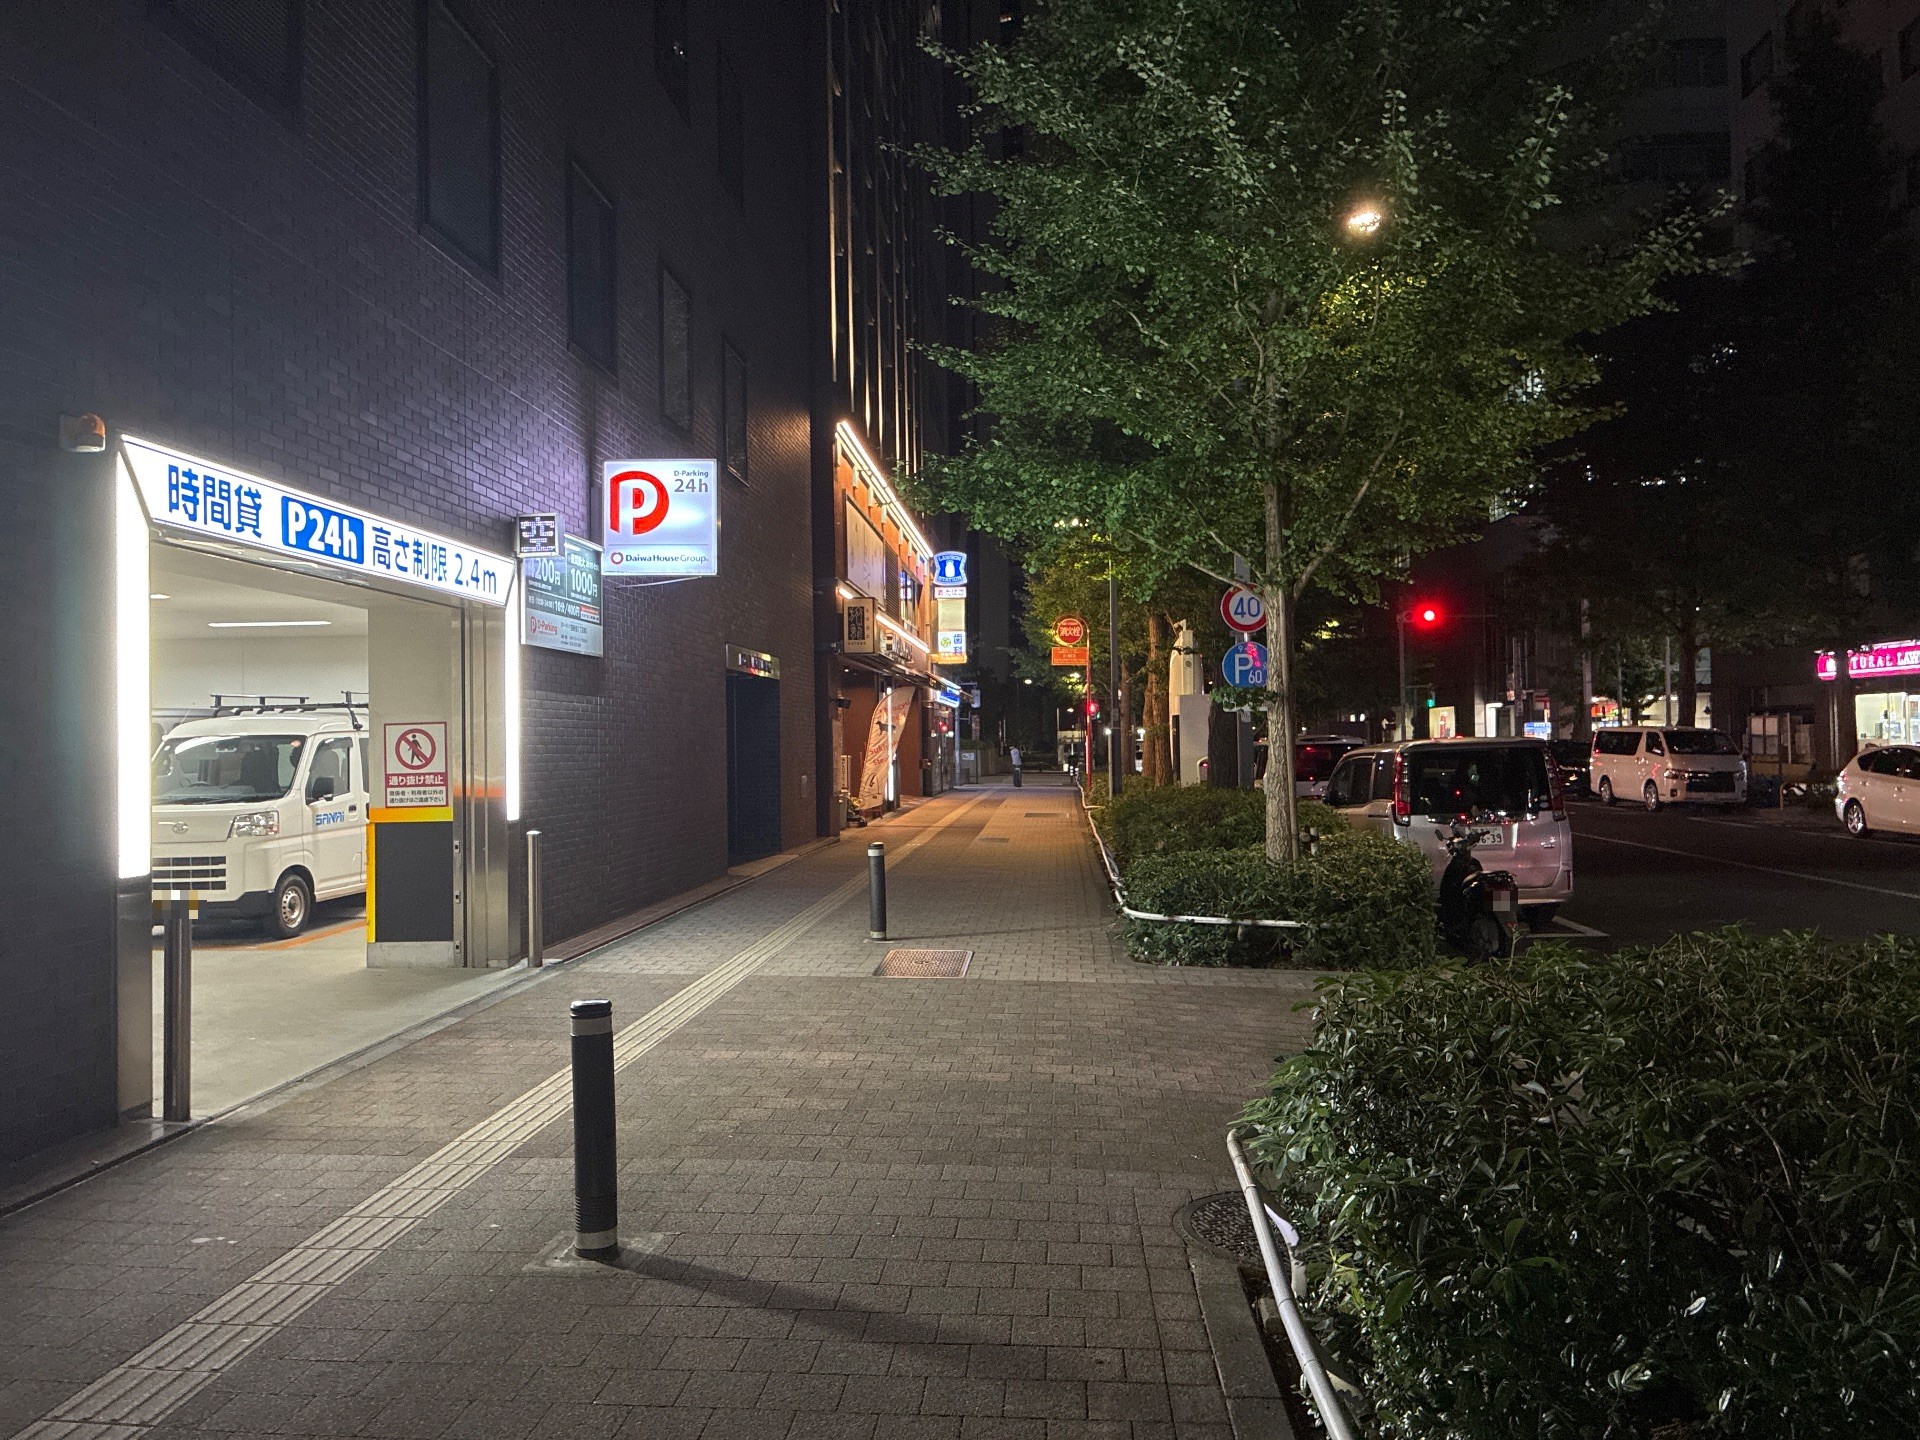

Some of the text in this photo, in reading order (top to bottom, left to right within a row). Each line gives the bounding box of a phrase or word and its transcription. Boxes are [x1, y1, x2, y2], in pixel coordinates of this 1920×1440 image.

[674, 470, 709, 478] D-Parking
[674, 479, 709, 493] 24h
[168, 464, 497, 595] 時間貸 P24h 高さ制限 2.4m
[571, 568, 598, 597] 1000円
[1233, 597, 1261, 618] 40
[1234, 653, 1253, 684] P
[1850, 654, 1892, 669] TURAL
[1248, 670, 1262, 684] 60
[389, 774, 444, 786] 通り抜け禁止
